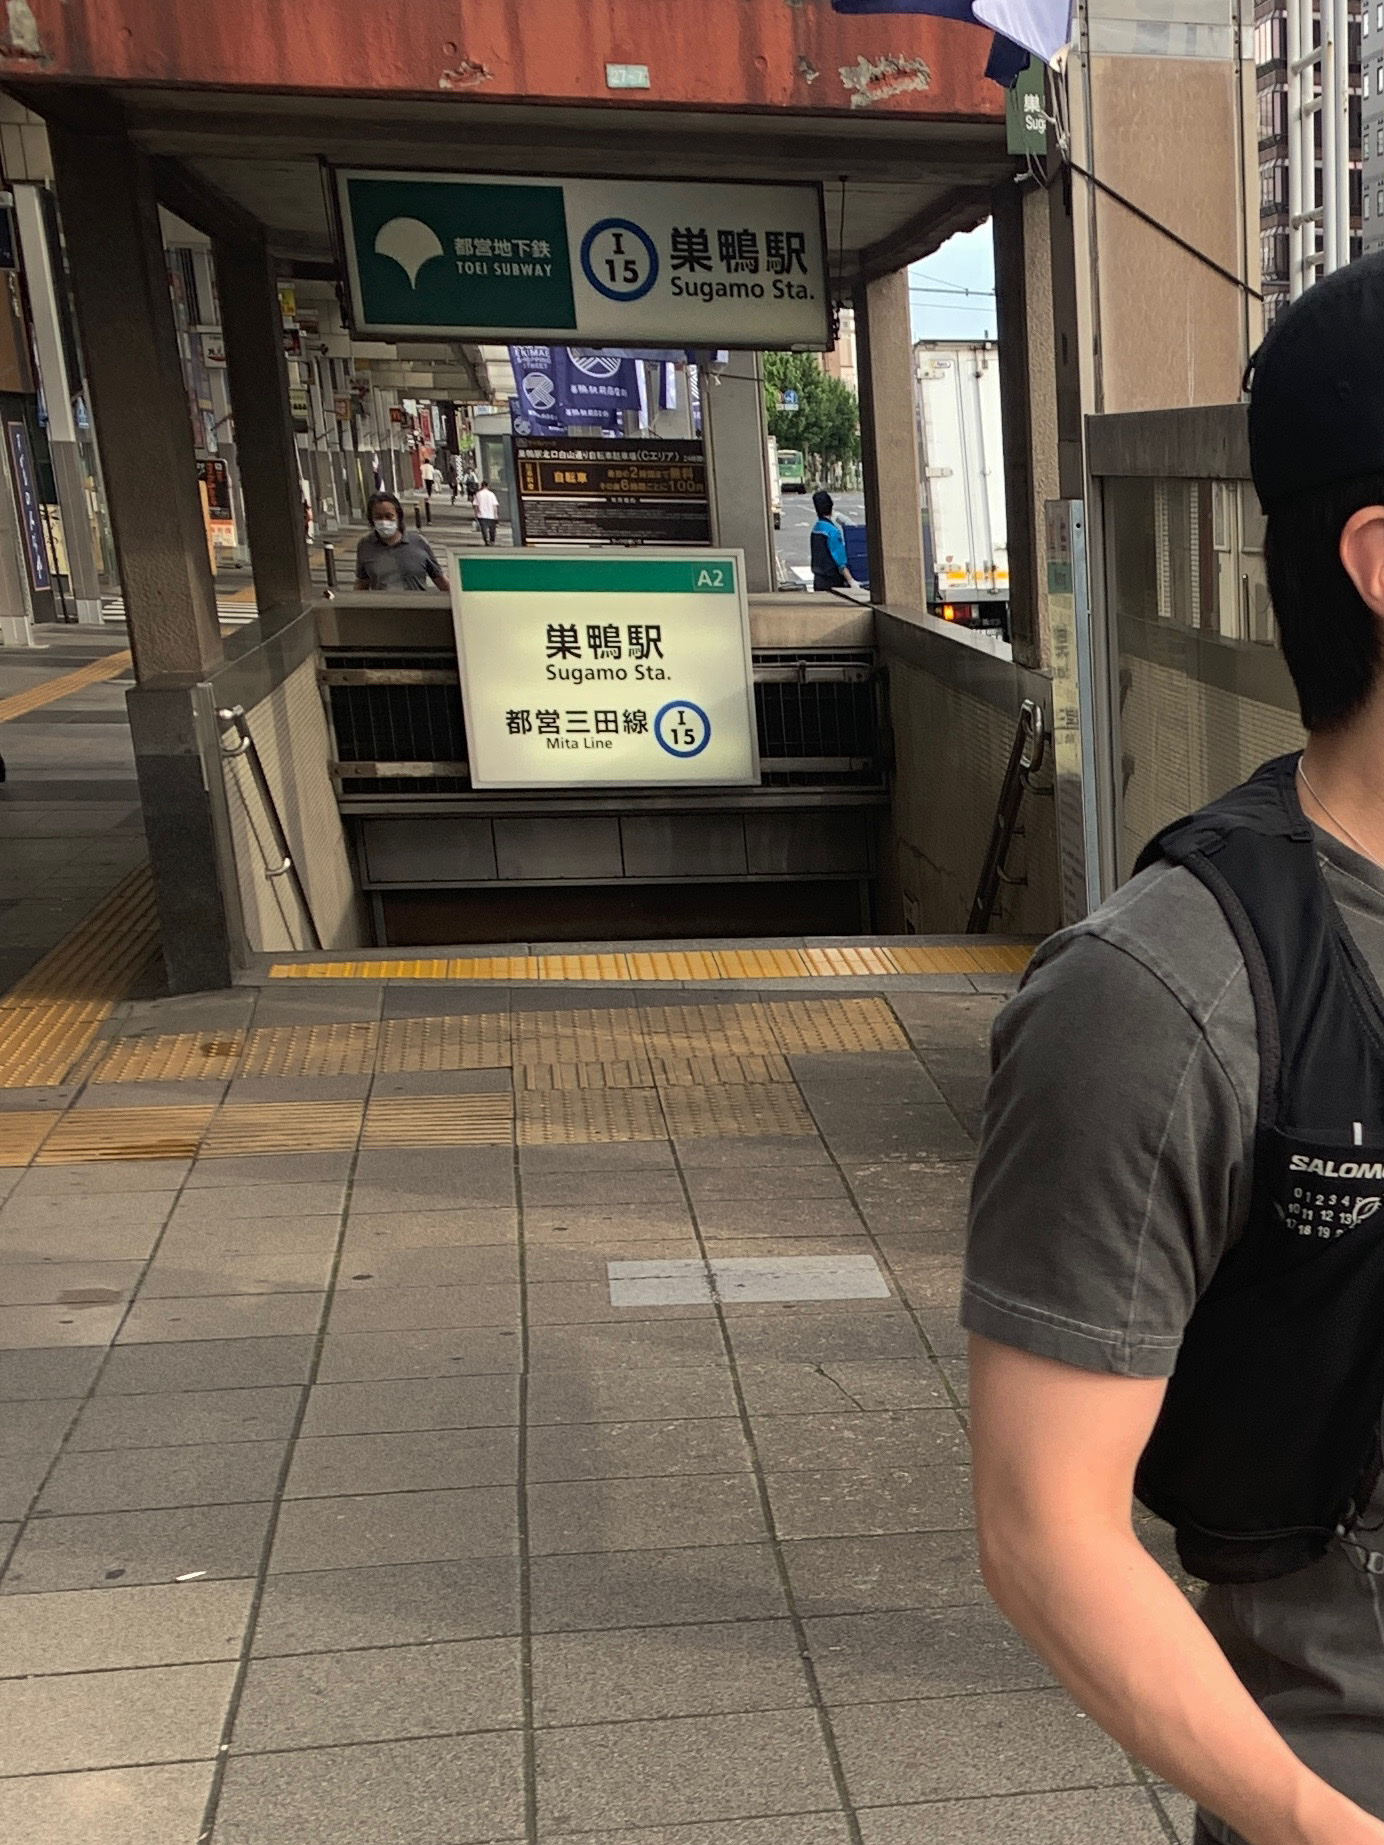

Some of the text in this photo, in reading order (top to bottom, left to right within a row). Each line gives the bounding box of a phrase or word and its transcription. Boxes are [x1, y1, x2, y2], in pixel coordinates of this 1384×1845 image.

[1023, 93, 1041, 113] 巣
[454, 236, 552, 259] 都営地下鉄
[612, 232, 624, 255] I
[670, 226, 808, 277] 巣鴨駅
[456, 260, 553, 278] TOEI SUBWAY
[604, 259, 639, 285] 15
[670, 276, 816, 303] Sugamo Sta.
[553, 470, 588, 484] 自転車
[697, 569, 724, 588] A2
[545, 623, 665, 661] 巣鴨駅
[546, 664, 672, 685] Sugamo Sta.
[505, 708, 649, 736] 都営三田線
[546, 736, 613, 750] Mita Line
[670, 728, 696, 746] 15
[1293, 1187, 1303, 1199] 0
[1306, 1191, 1312, 1203] 1
[1315, 1194, 1325, 1206] 2
[1328, 1194, 1338, 1206] 3
[1340, 1195, 1351, 1207] 4
[1287, 1203, 1353, 1225] 10 11 12 13
[1297, 1224, 1312, 1236] 18
[1317, 1225, 1331, 1239] 19
